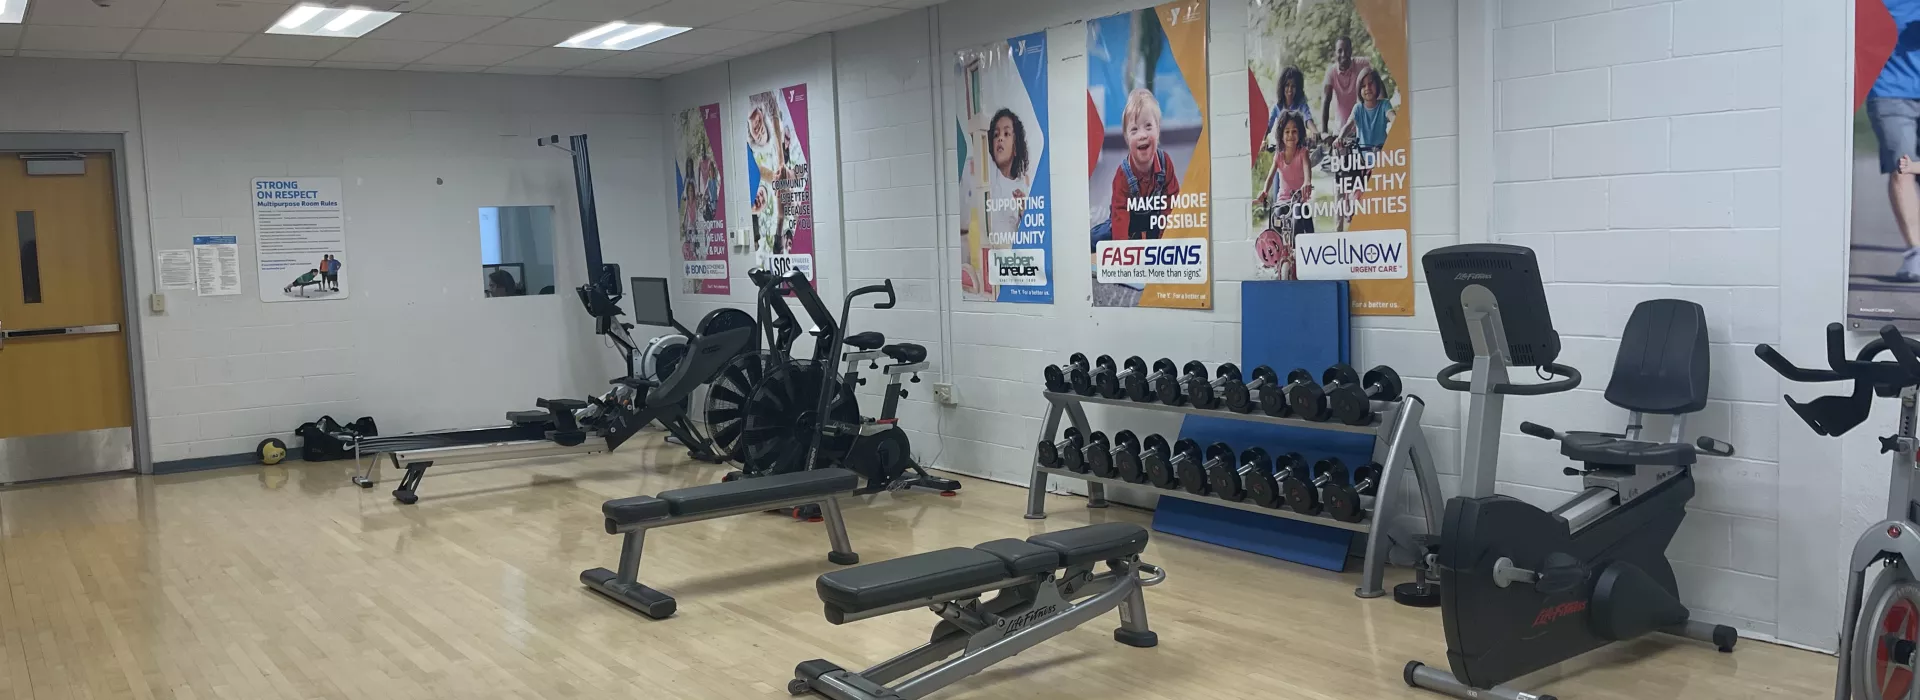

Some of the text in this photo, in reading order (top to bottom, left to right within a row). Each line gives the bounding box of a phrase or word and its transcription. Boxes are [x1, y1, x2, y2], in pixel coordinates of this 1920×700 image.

[1330, 149, 1406, 172] BUILDING
[795, 164, 808, 174] OUR
[256, 181, 298, 190] STRONG
[772, 178, 808, 190] COMMUNITY
[1334, 172, 1406, 194] HEALTHY
[257, 190, 318, 199] ON RESPECT
[781, 191, 809, 203] IS BETTER
[986, 195, 1045, 212] SUPPORTING
[1127, 192, 1207, 211] MAKES MORE
[1293, 195, 1407, 219] COMMUNITIES
[784, 204, 810, 216] BECAUSE
[789, 219, 811, 229] OF YOU
[1024, 213, 1045, 228] OUR
[1150, 212, 1207, 230] POSSIBLE
[989, 231, 1045, 245] COMMUNITY
[709, 246, 714, 255] &
[714, 246, 725, 255] PLAY
[994, 252, 1034, 266] hueber
[691, 265, 707, 274] BOND
[999, 264, 1039, 276] breuer
[1102, 269, 1116, 277] More
[1117, 269, 1131, 277] than
[1133, 268, 1146, 277] fast.
[1148, 269, 1165, 277] More
[1167, 268, 1181, 277] than
[1368, 300, 1388, 308] better
